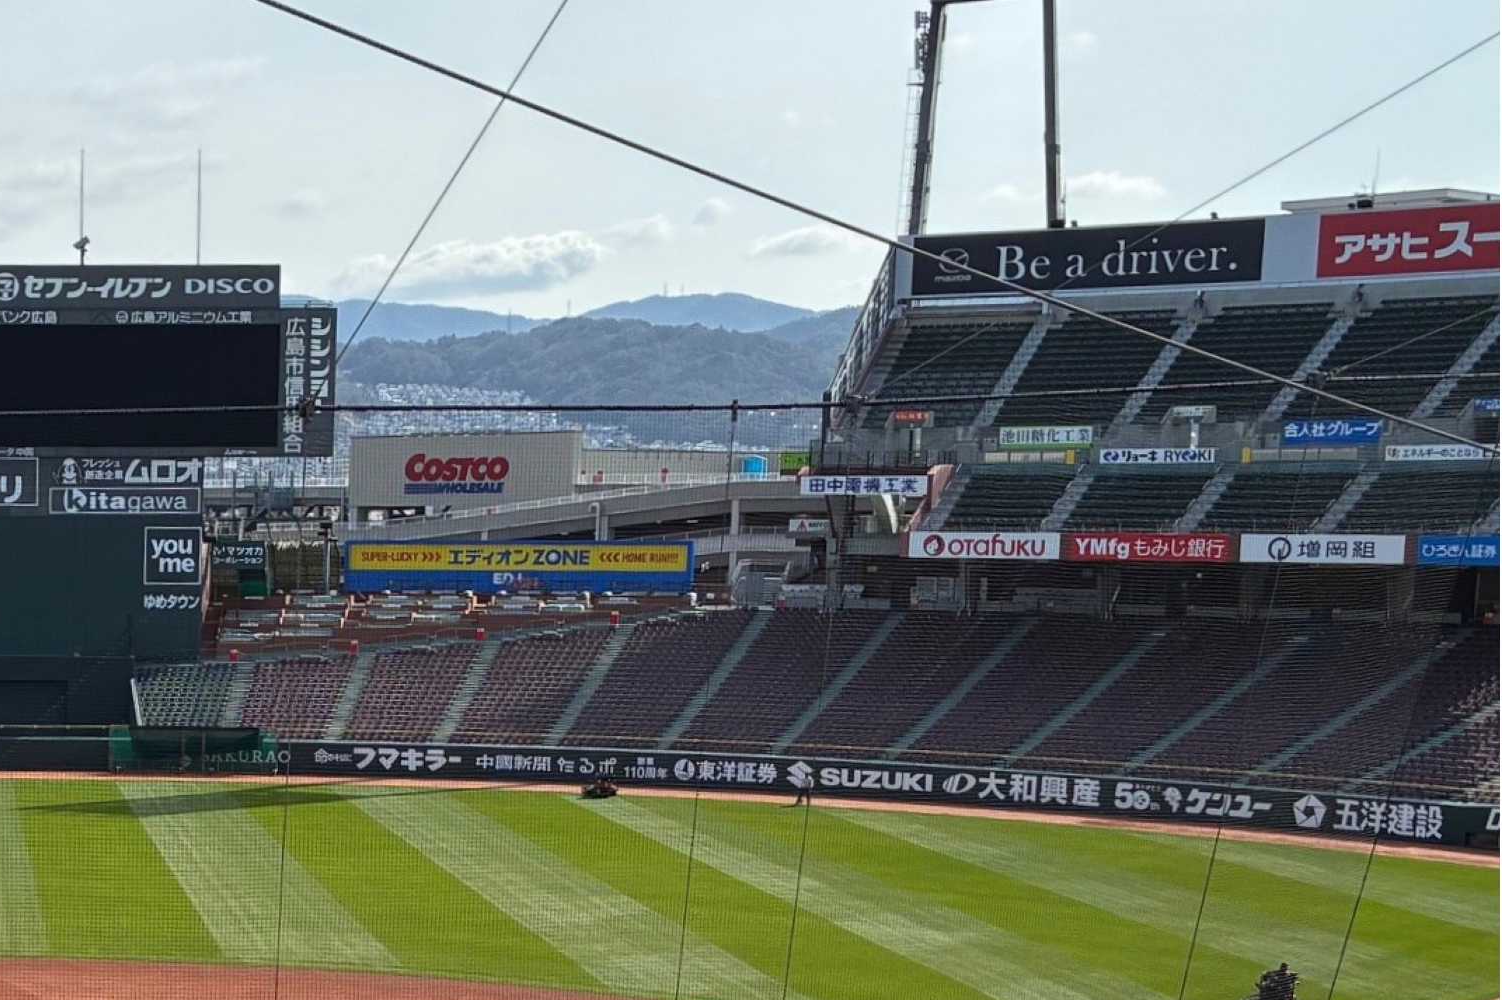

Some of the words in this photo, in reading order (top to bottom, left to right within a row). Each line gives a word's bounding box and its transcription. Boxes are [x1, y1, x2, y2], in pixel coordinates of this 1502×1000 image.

[1334, 221, 1500, 265] アサヒスー
[996, 245, 1050, 282] Be
[1066, 254, 1088, 277] a
[1101, 236, 1238, 276] driver.
[184, 278, 275, 294] DISCO
[1284, 421, 1379, 437] 合人社グループ
[124, 458, 203, 483] ムロオ
[405, 453, 510, 482] COSTCO
[434, 481, 506, 494] WHOLESALE
[809, 478, 919, 493] 田中電機工業
[151, 538, 193, 559] you
[448, 551, 532, 565] エディオン
[533, 550, 590, 566] ZONE
[621, 552, 648, 564] HOME
[1075, 538, 1129, 559] YMfg
[1133, 539, 1225, 557] もみじ銀行
[1297, 541, 1376, 559] 増岡組
[158, 557, 195, 573] me
[143, 594, 200, 609] ゆめタウン
[353, 747, 462, 771] フマキラー
[624, 766, 668, 779] 110周年
[698, 760, 778, 784] 東洋証券
[819, 767, 934, 793] SUZUKI
[978, 771, 1101, 808] 大和興産
[1185, 788, 1273, 819] ケンユー
[1333, 798, 1444, 840] 五洋建設
